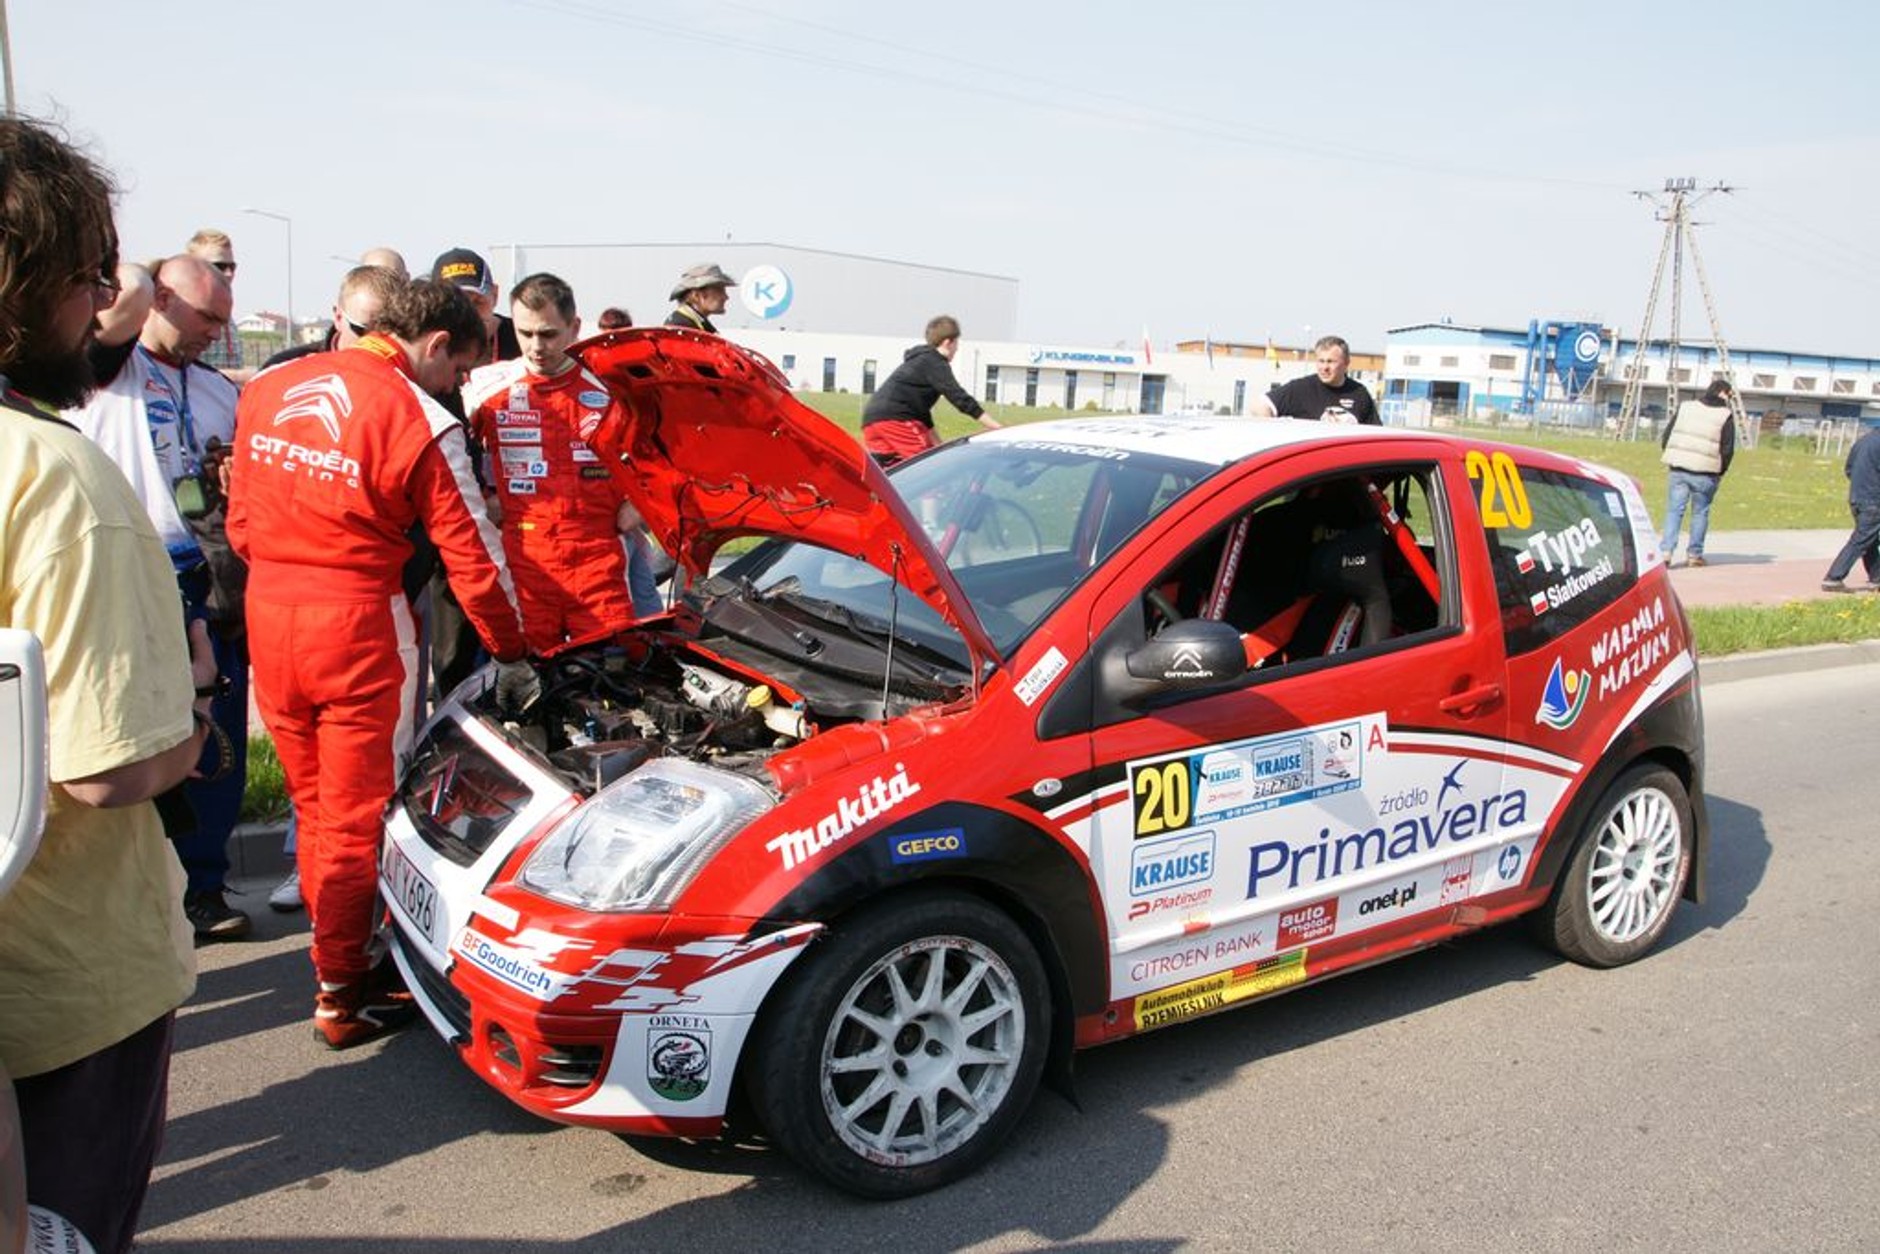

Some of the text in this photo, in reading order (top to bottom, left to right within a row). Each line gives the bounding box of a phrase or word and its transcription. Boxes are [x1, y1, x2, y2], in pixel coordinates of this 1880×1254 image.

[1465, 450, 1533, 530] 20
[1528, 517, 1602, 575] Typa
[1546, 555, 1615, 609] Siatkowski
[1591, 596, 1665, 668] WARMIA
[1598, 627, 1671, 701] MAZURY
[1367, 724, 1385, 751] A
[1255, 754, 1302, 777] KRAUSE
[1136, 761, 1190, 835] 20
[1379, 787, 1429, 816] źródło
[896, 836, 960, 856] GEFCO
[1246, 788, 1527, 900] Primavera
[1134, 851, 1211, 888] KRAUSE
[1151, 887, 1213, 912] Platinum
[1281, 905, 1326, 929] auto
[462, 930, 552, 992] BFGoodrich
[1215, 929, 1263, 959] BANK
[1141, 978, 1225, 1012] Automobilklub
[648, 1015, 711, 1029] ORNETA
